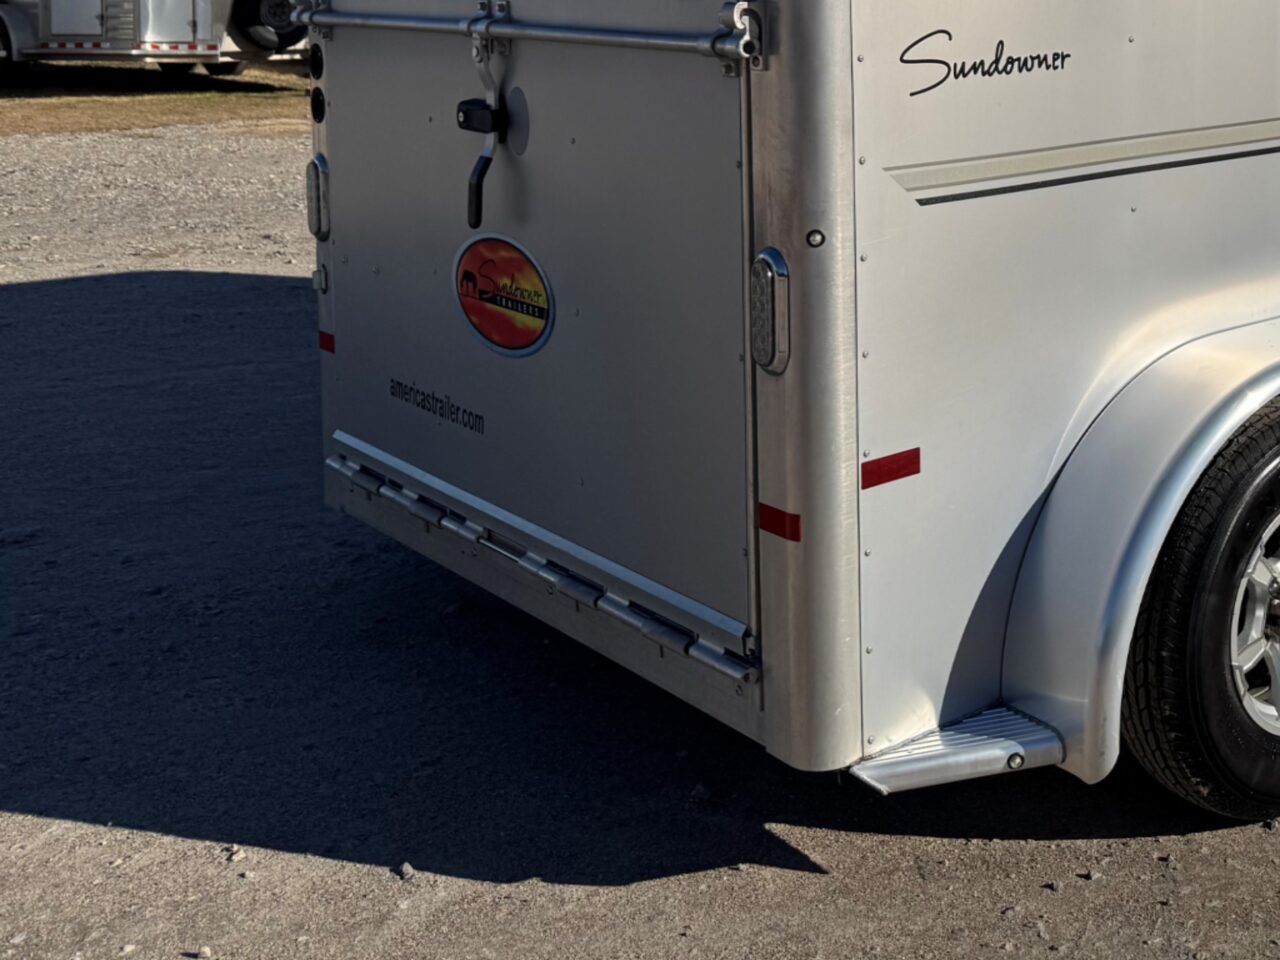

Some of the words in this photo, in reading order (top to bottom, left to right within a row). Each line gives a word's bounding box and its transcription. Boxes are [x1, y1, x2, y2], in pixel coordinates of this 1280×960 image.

[899, 28, 1072, 97] Sundowner
[478, 258, 543, 305] Sundowner
[496, 296, 540, 317] TRAILERS
[389, 378, 485, 436] americastrailer.com
